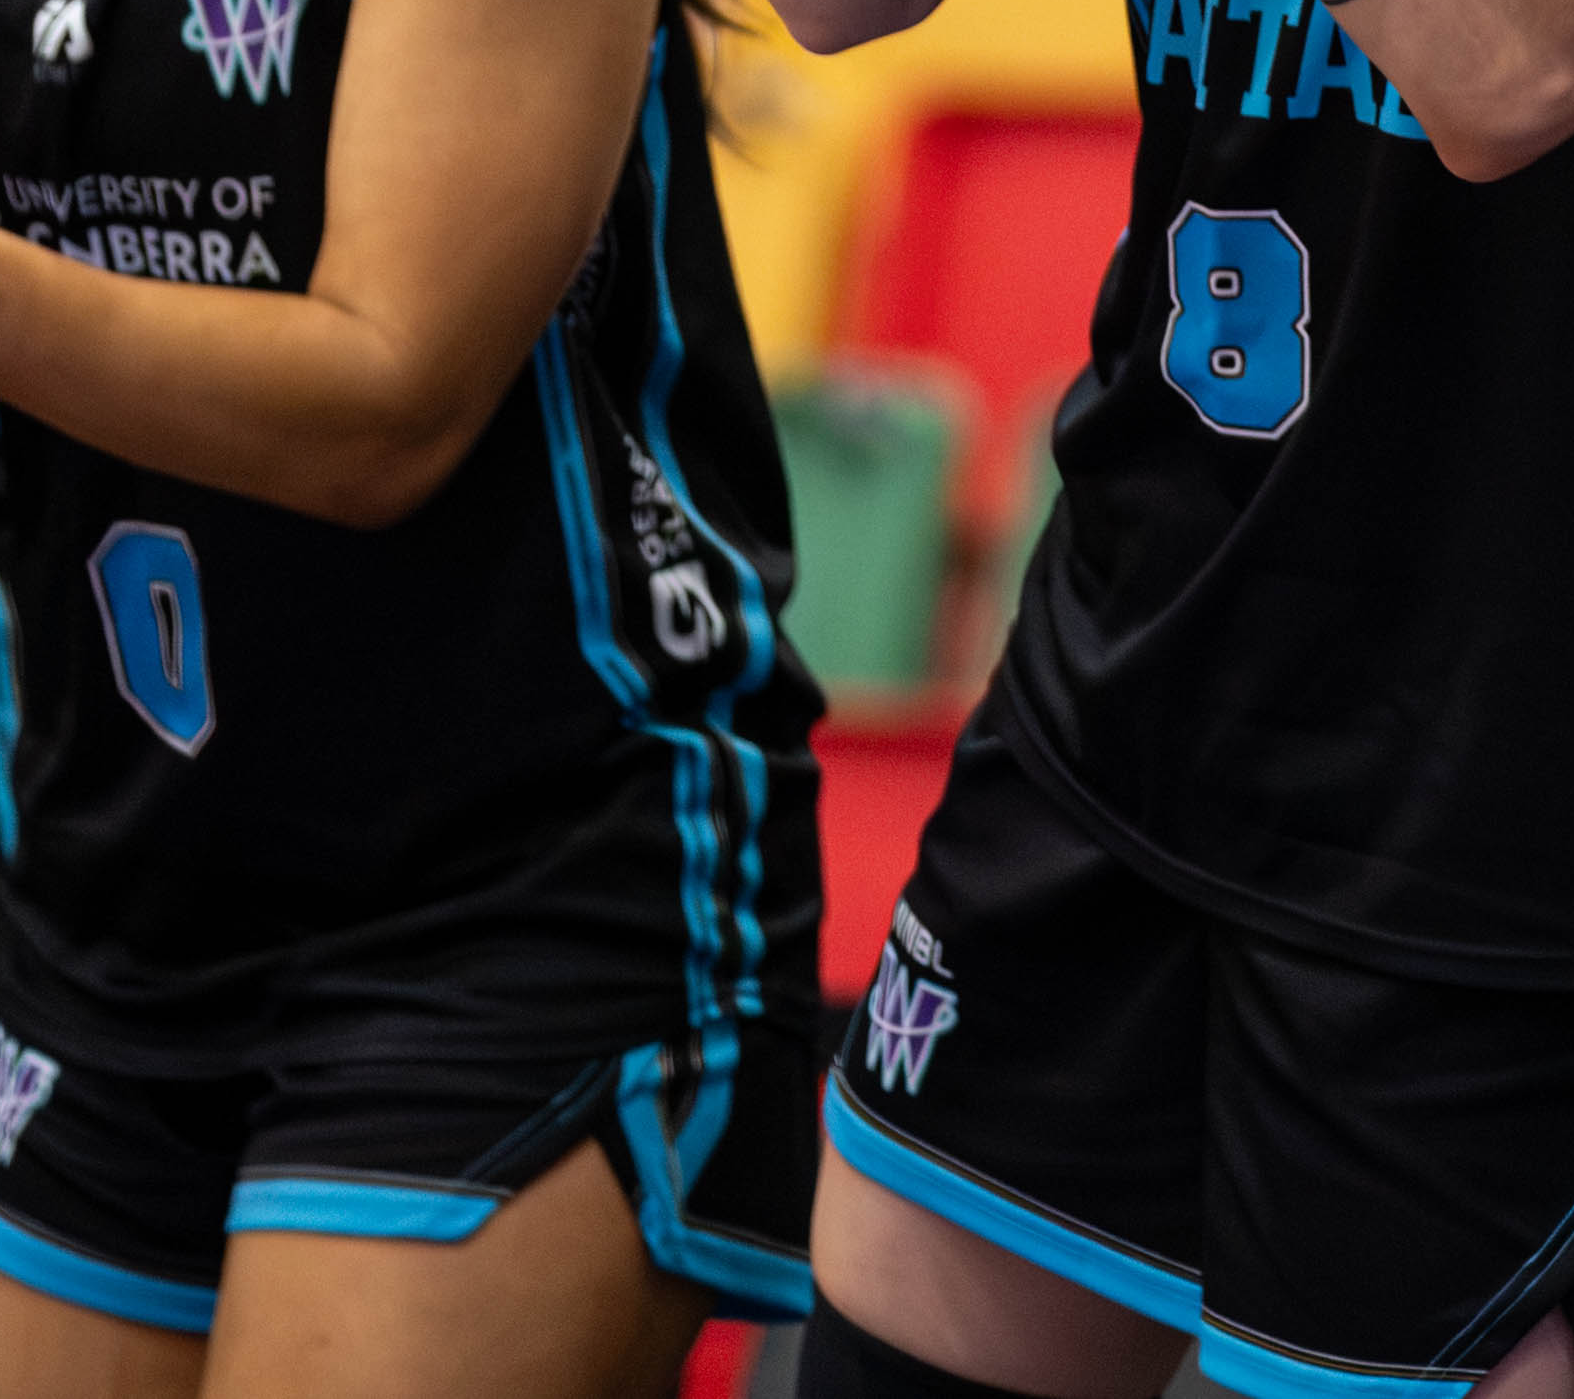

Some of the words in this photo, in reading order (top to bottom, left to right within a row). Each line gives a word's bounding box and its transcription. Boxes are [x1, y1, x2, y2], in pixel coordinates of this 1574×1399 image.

[211, 174, 275, 220] OF
[1161, 200, 1310, 440] 8
[87, 520, 216, 757] 0
